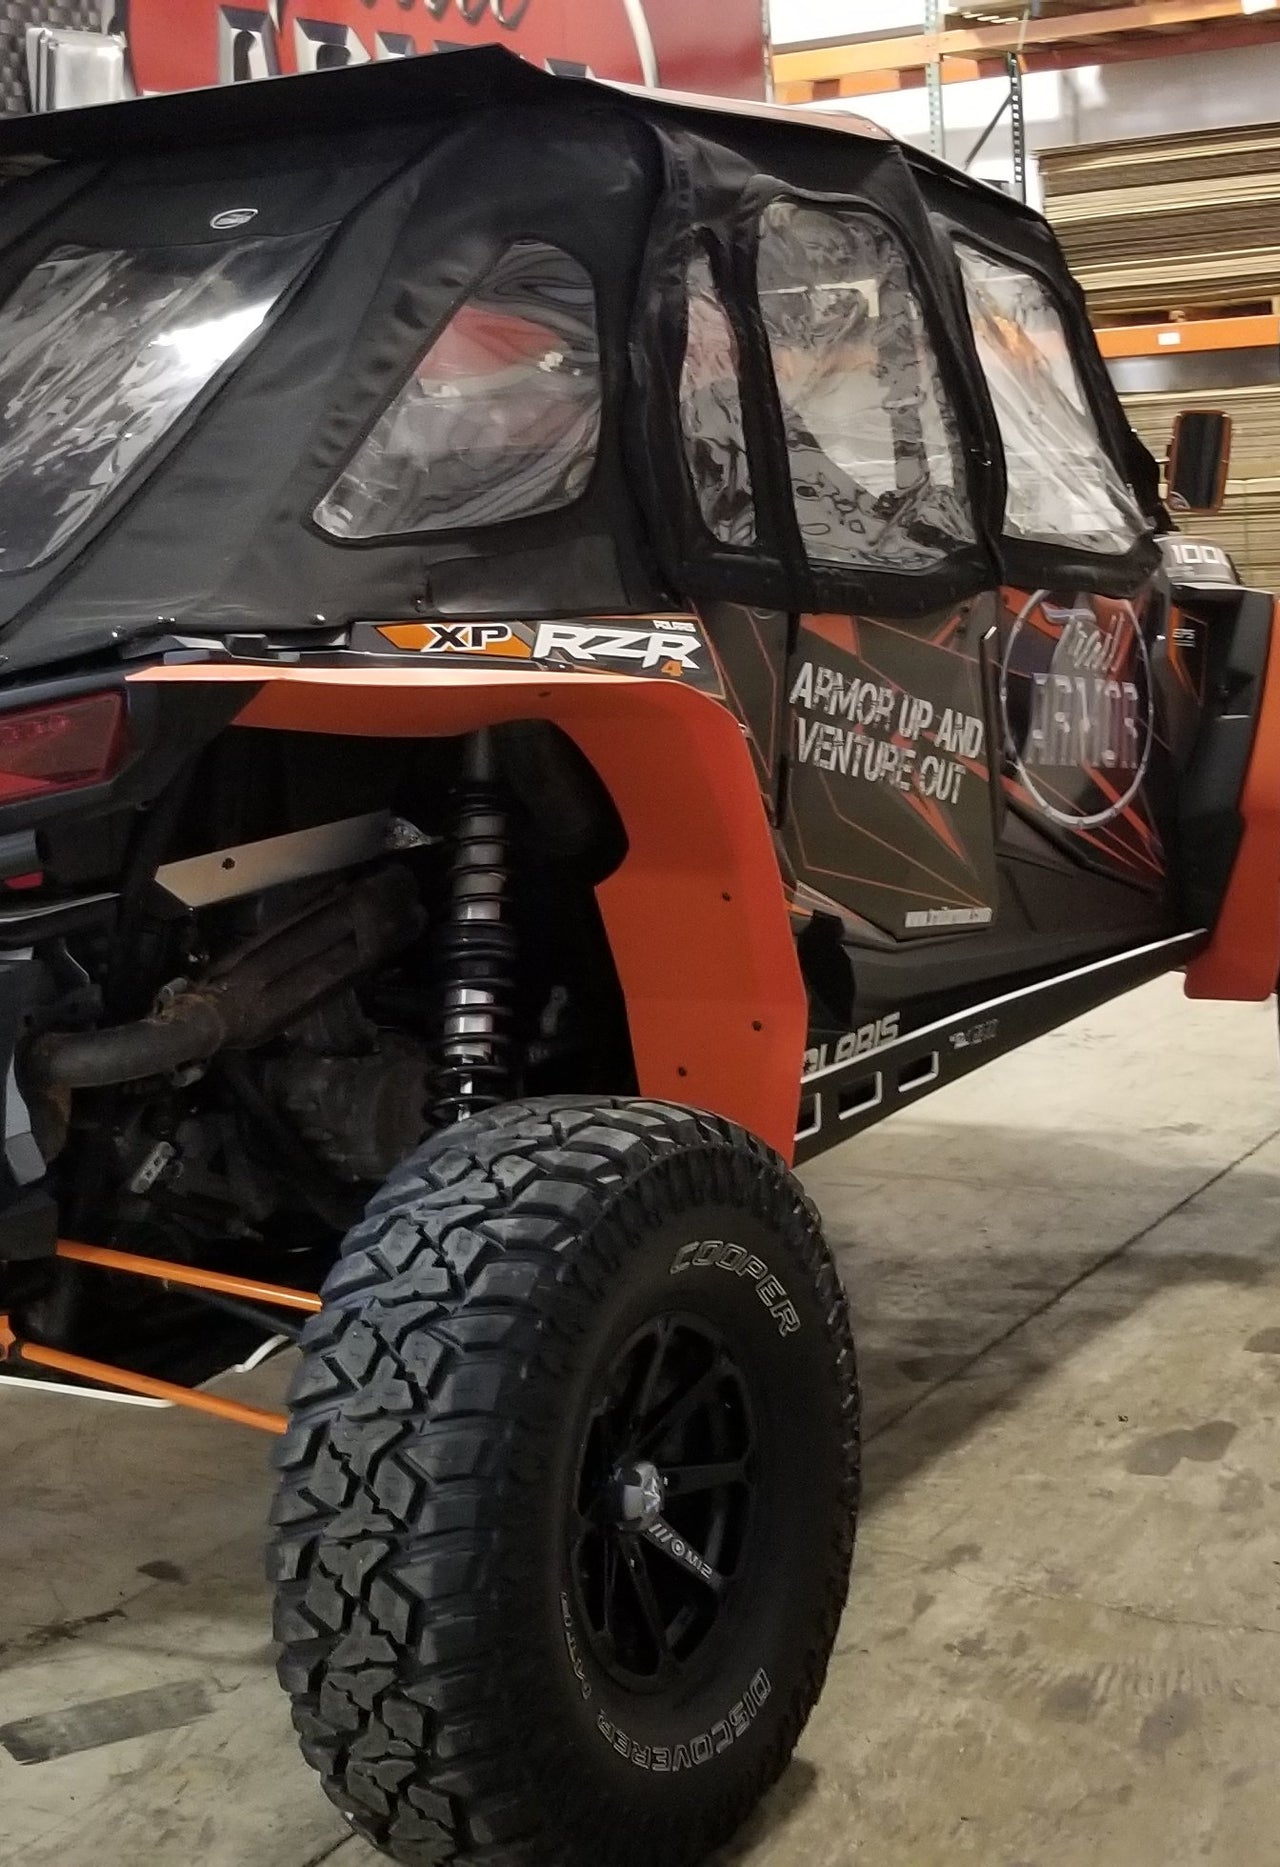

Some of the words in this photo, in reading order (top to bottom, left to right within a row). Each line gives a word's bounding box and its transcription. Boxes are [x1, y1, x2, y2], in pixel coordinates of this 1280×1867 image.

[422, 623, 512, 653] XP
[533, 623, 702, 669] RZR
[661, 660, 683, 677] 4
[788, 662, 896, 732] ARMOR
[899, 694, 933, 741] UP
[934, 708, 985, 759] AND
[797, 716, 917, 792] VENTURE
[919, 755, 967, 804] OUT
[803, 1011, 900, 1076] OLARIS
[669, 1239, 802, 1338] COOPER
[596, 1666, 773, 1773] DISCOVERER
